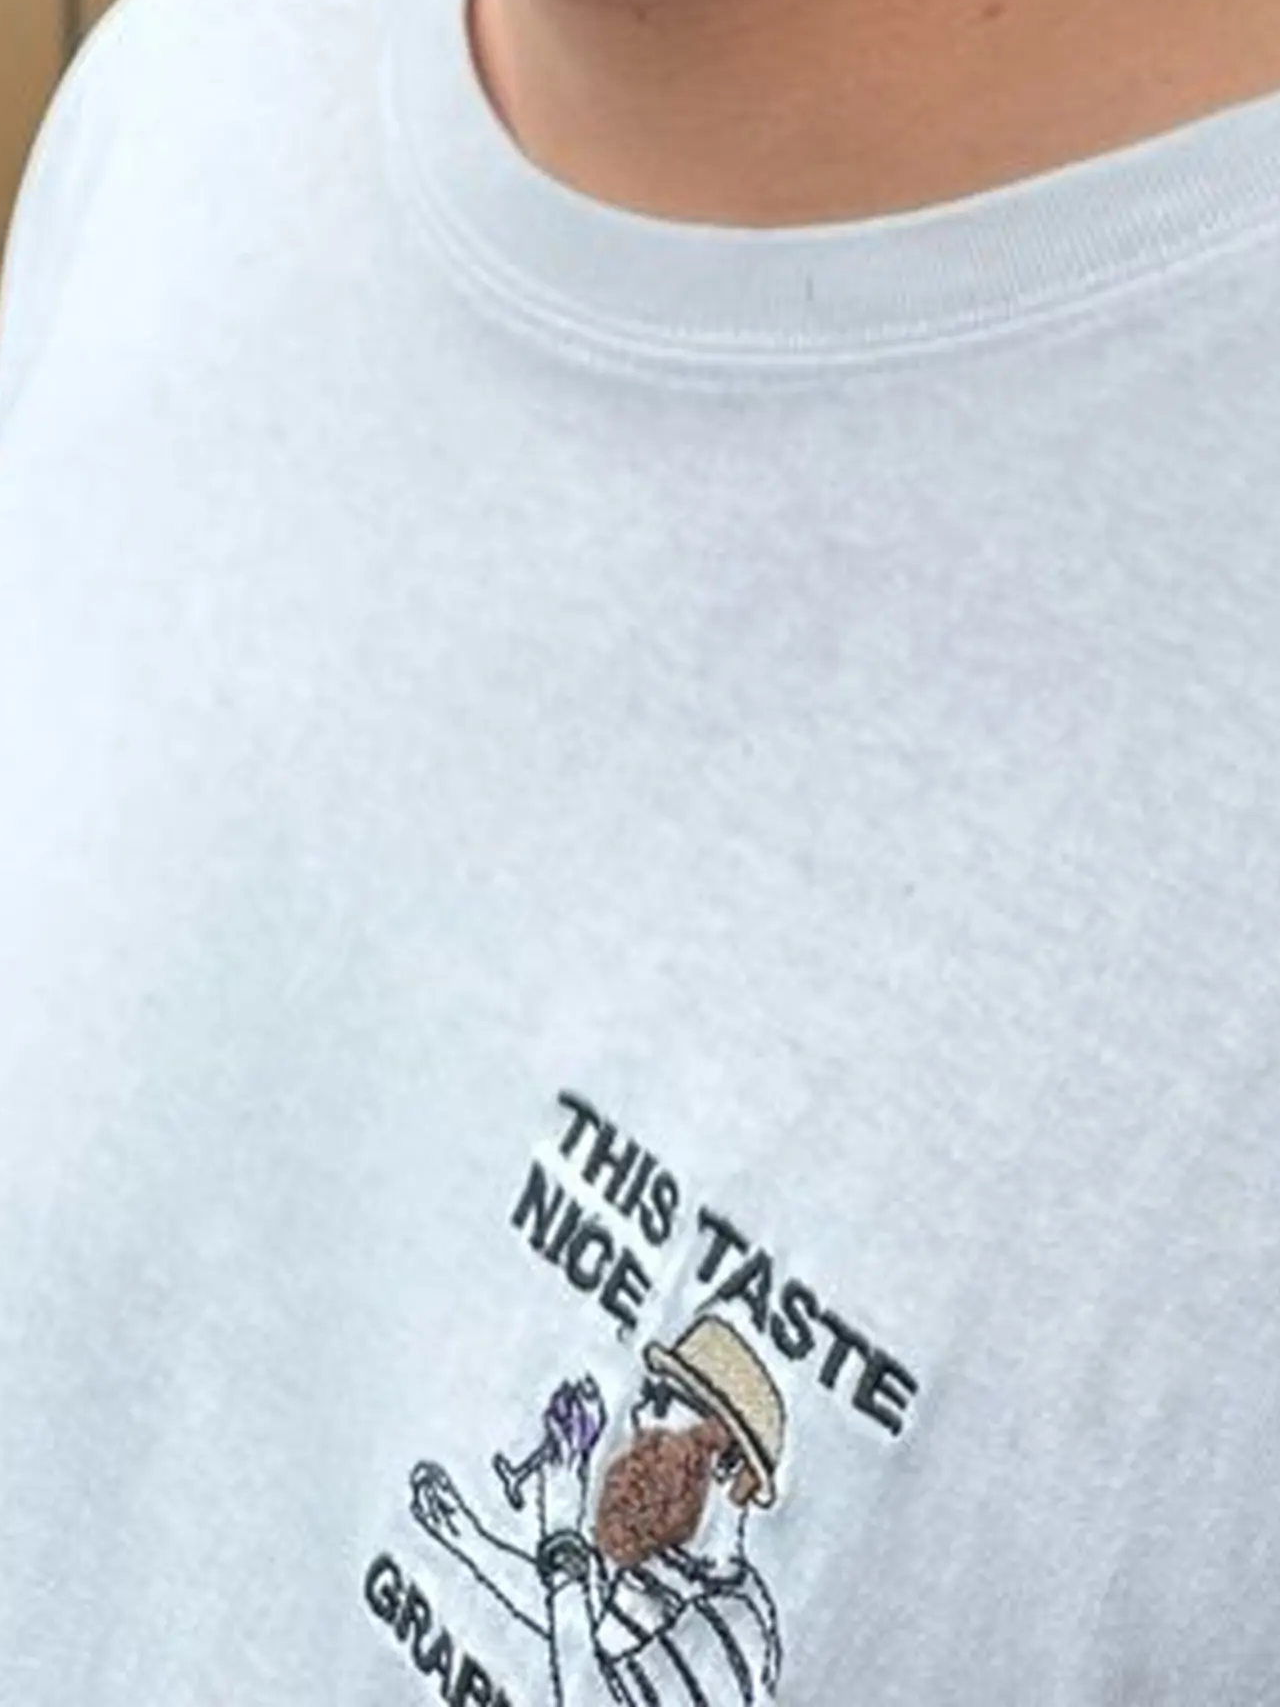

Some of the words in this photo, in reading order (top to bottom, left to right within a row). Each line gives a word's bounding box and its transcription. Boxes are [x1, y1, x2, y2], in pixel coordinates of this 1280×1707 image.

[510, 1161, 652, 1329] NICE
[558, 1091, 680, 1247] THIS
[694, 1208, 919, 1436] TASTE
[364, 1552, 513, 1707] GRAP
